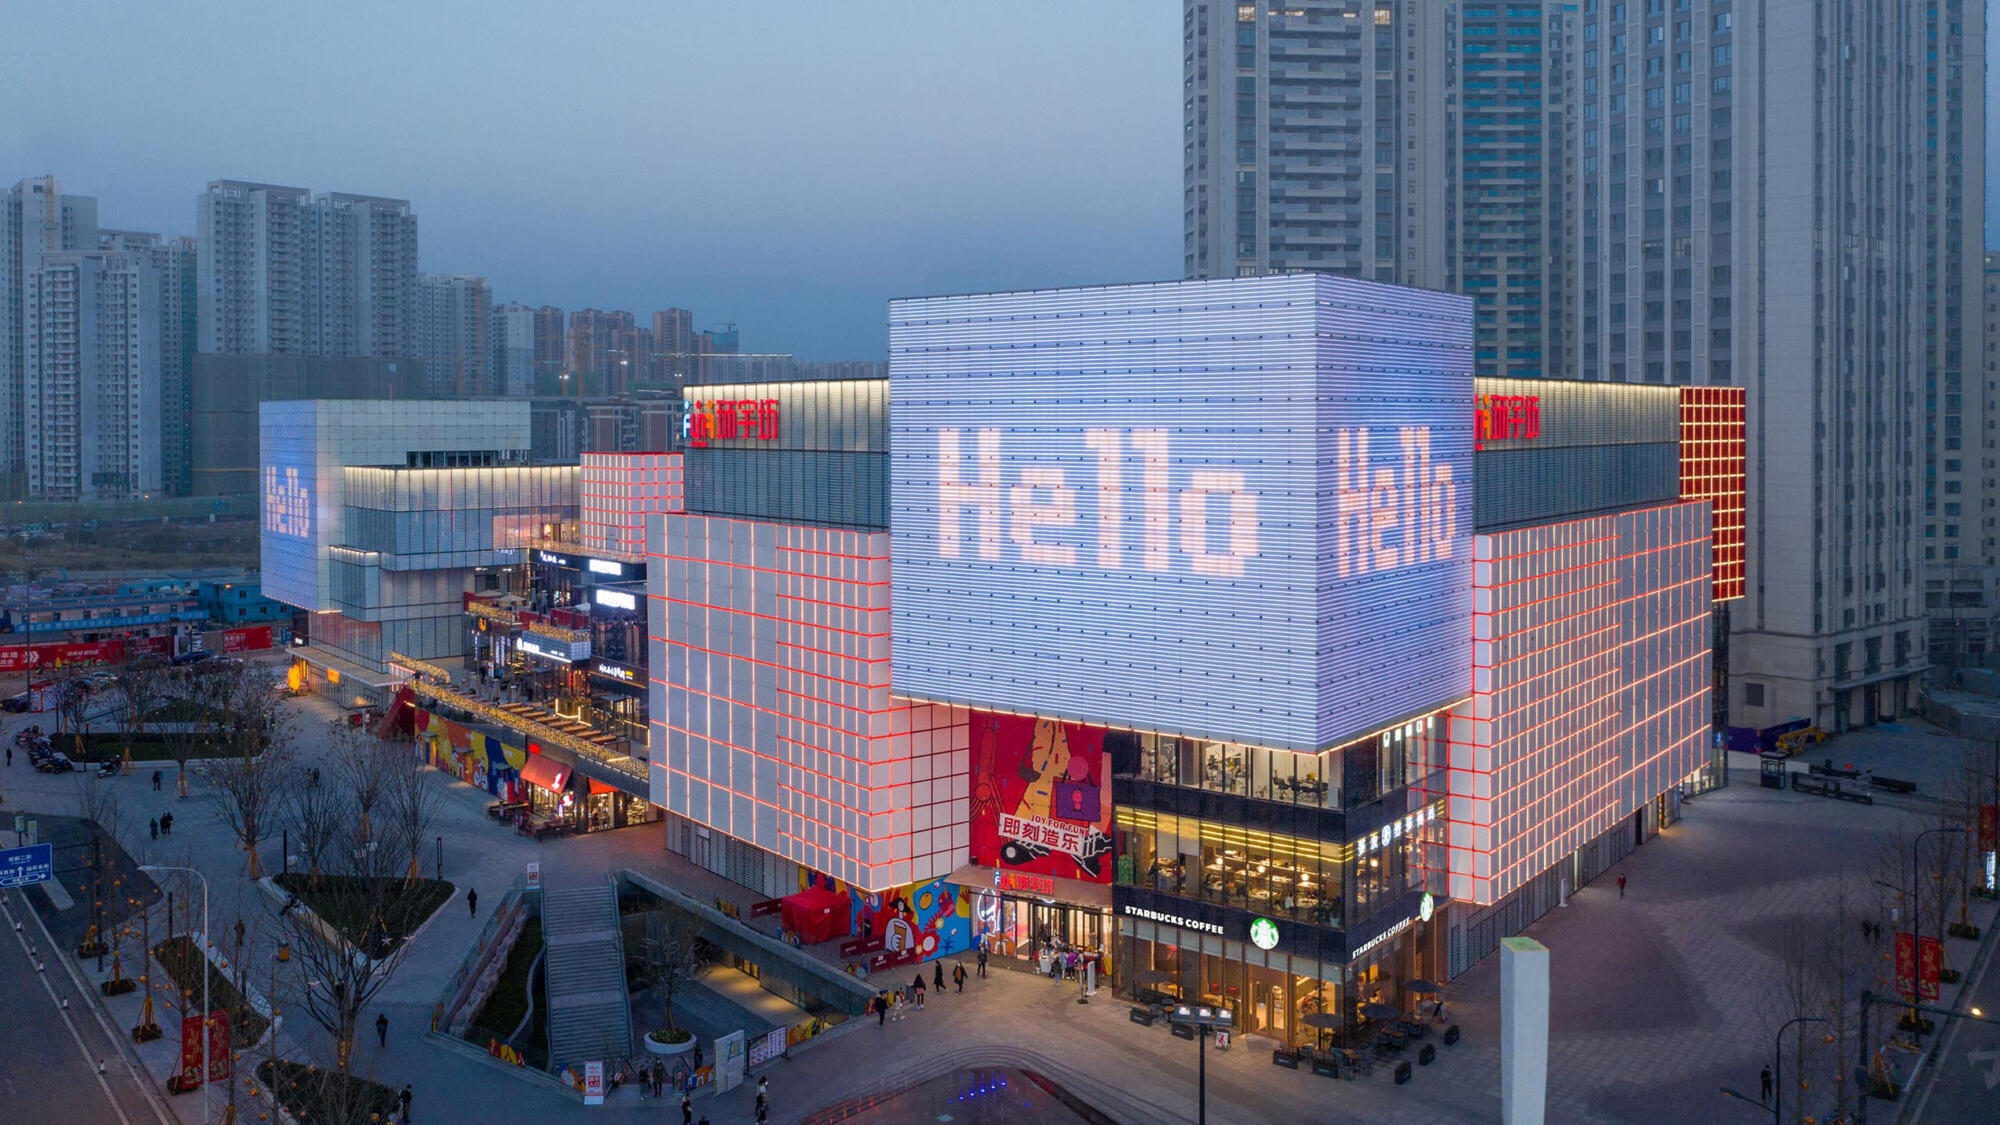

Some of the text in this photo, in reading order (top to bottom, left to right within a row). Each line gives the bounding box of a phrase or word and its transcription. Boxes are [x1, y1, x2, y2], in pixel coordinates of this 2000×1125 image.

[266, 466, 310, 538] Hello
[938, 428, 1258, 577] Hello
[1338, 426, 1456, 578] Hello
[1002, 817, 1080, 852] 即刻造乐
[1031, 815, 1046, 825] JOY
[1048, 820, 1067, 830] FOR
[1125, 905, 1224, 935] STARBUCKS COFFEE
[1352, 916, 1411, 960] STARBUCKS COFFEE
